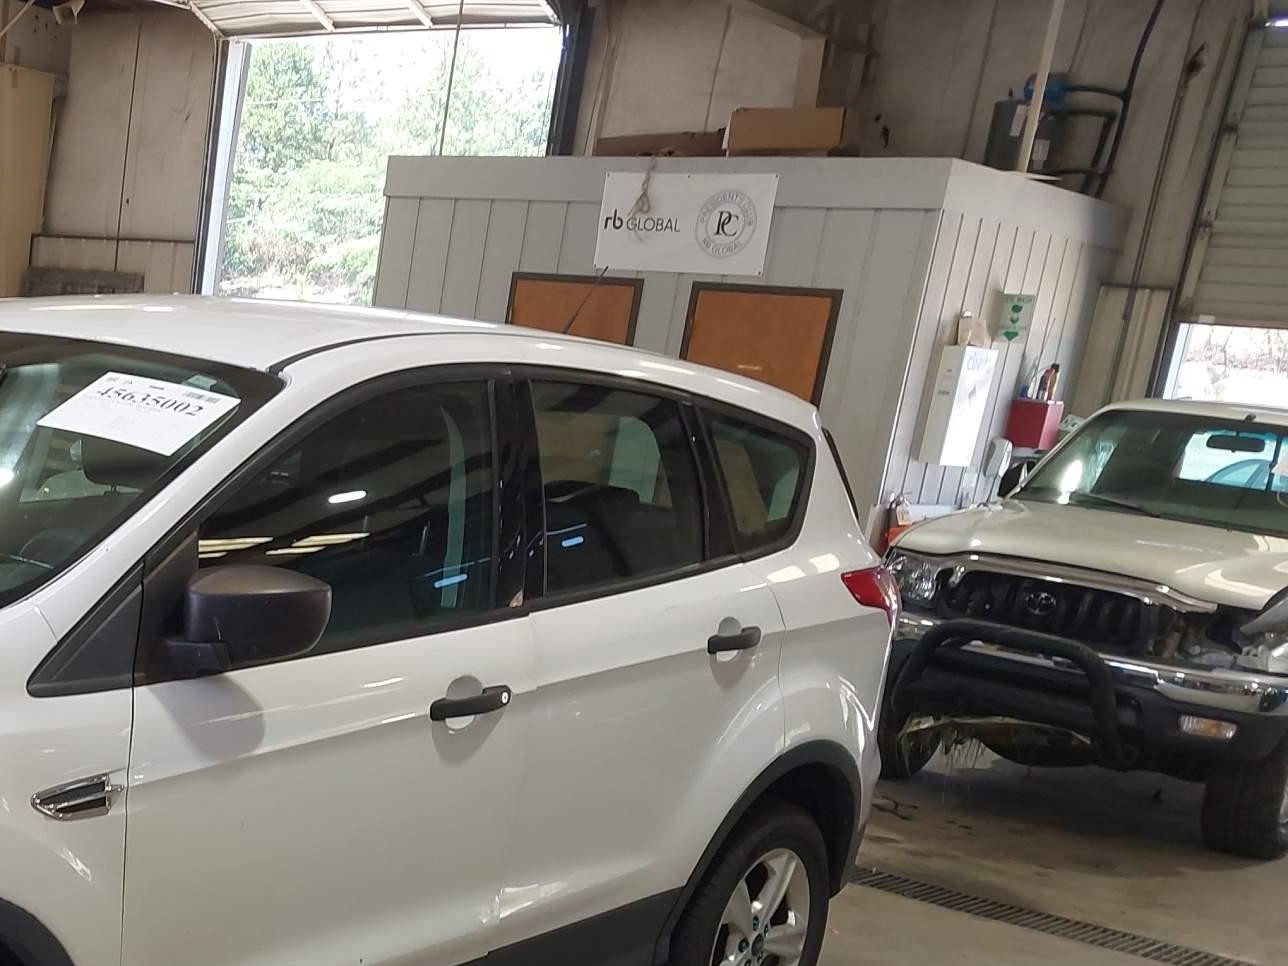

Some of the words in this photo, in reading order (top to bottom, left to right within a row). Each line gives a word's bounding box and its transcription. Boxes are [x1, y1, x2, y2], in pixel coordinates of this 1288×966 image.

[604, 208, 624, 231] rb
[626, 215, 681, 233] GLOBAL
[97, 386, 205, 417] 45635002
